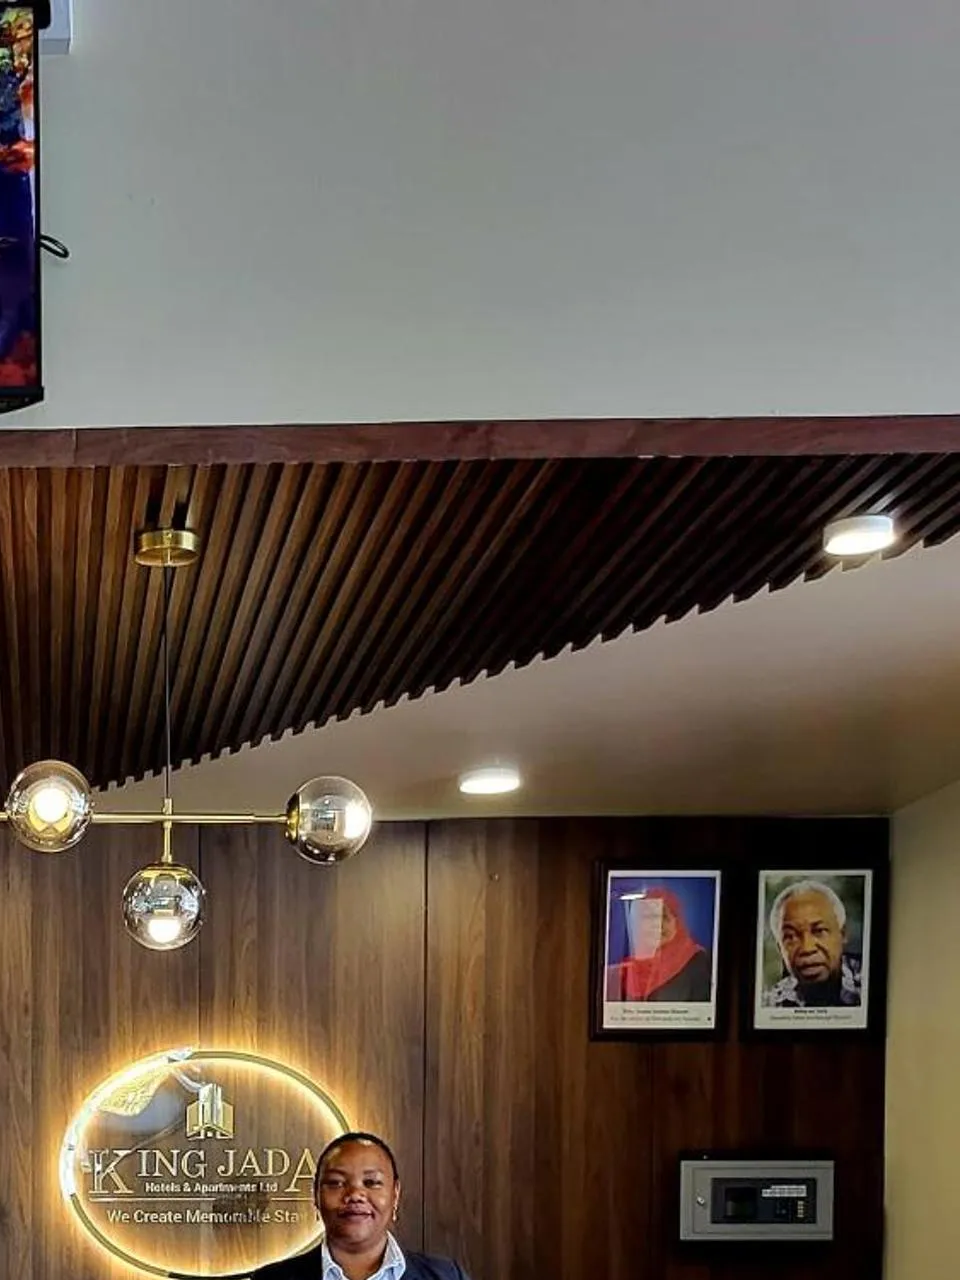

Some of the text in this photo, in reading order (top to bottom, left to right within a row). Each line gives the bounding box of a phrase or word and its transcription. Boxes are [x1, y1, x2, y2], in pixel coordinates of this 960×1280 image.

[88, 1148, 316, 1194] KING JADA
[145, 1182, 181, 1192] Hotels
[183, 1182, 191, 1192] &
[259, 1182, 278, 1192] Ltd
[107, 1209, 130, 1223] We
[133, 1209, 183, 1223] Create
